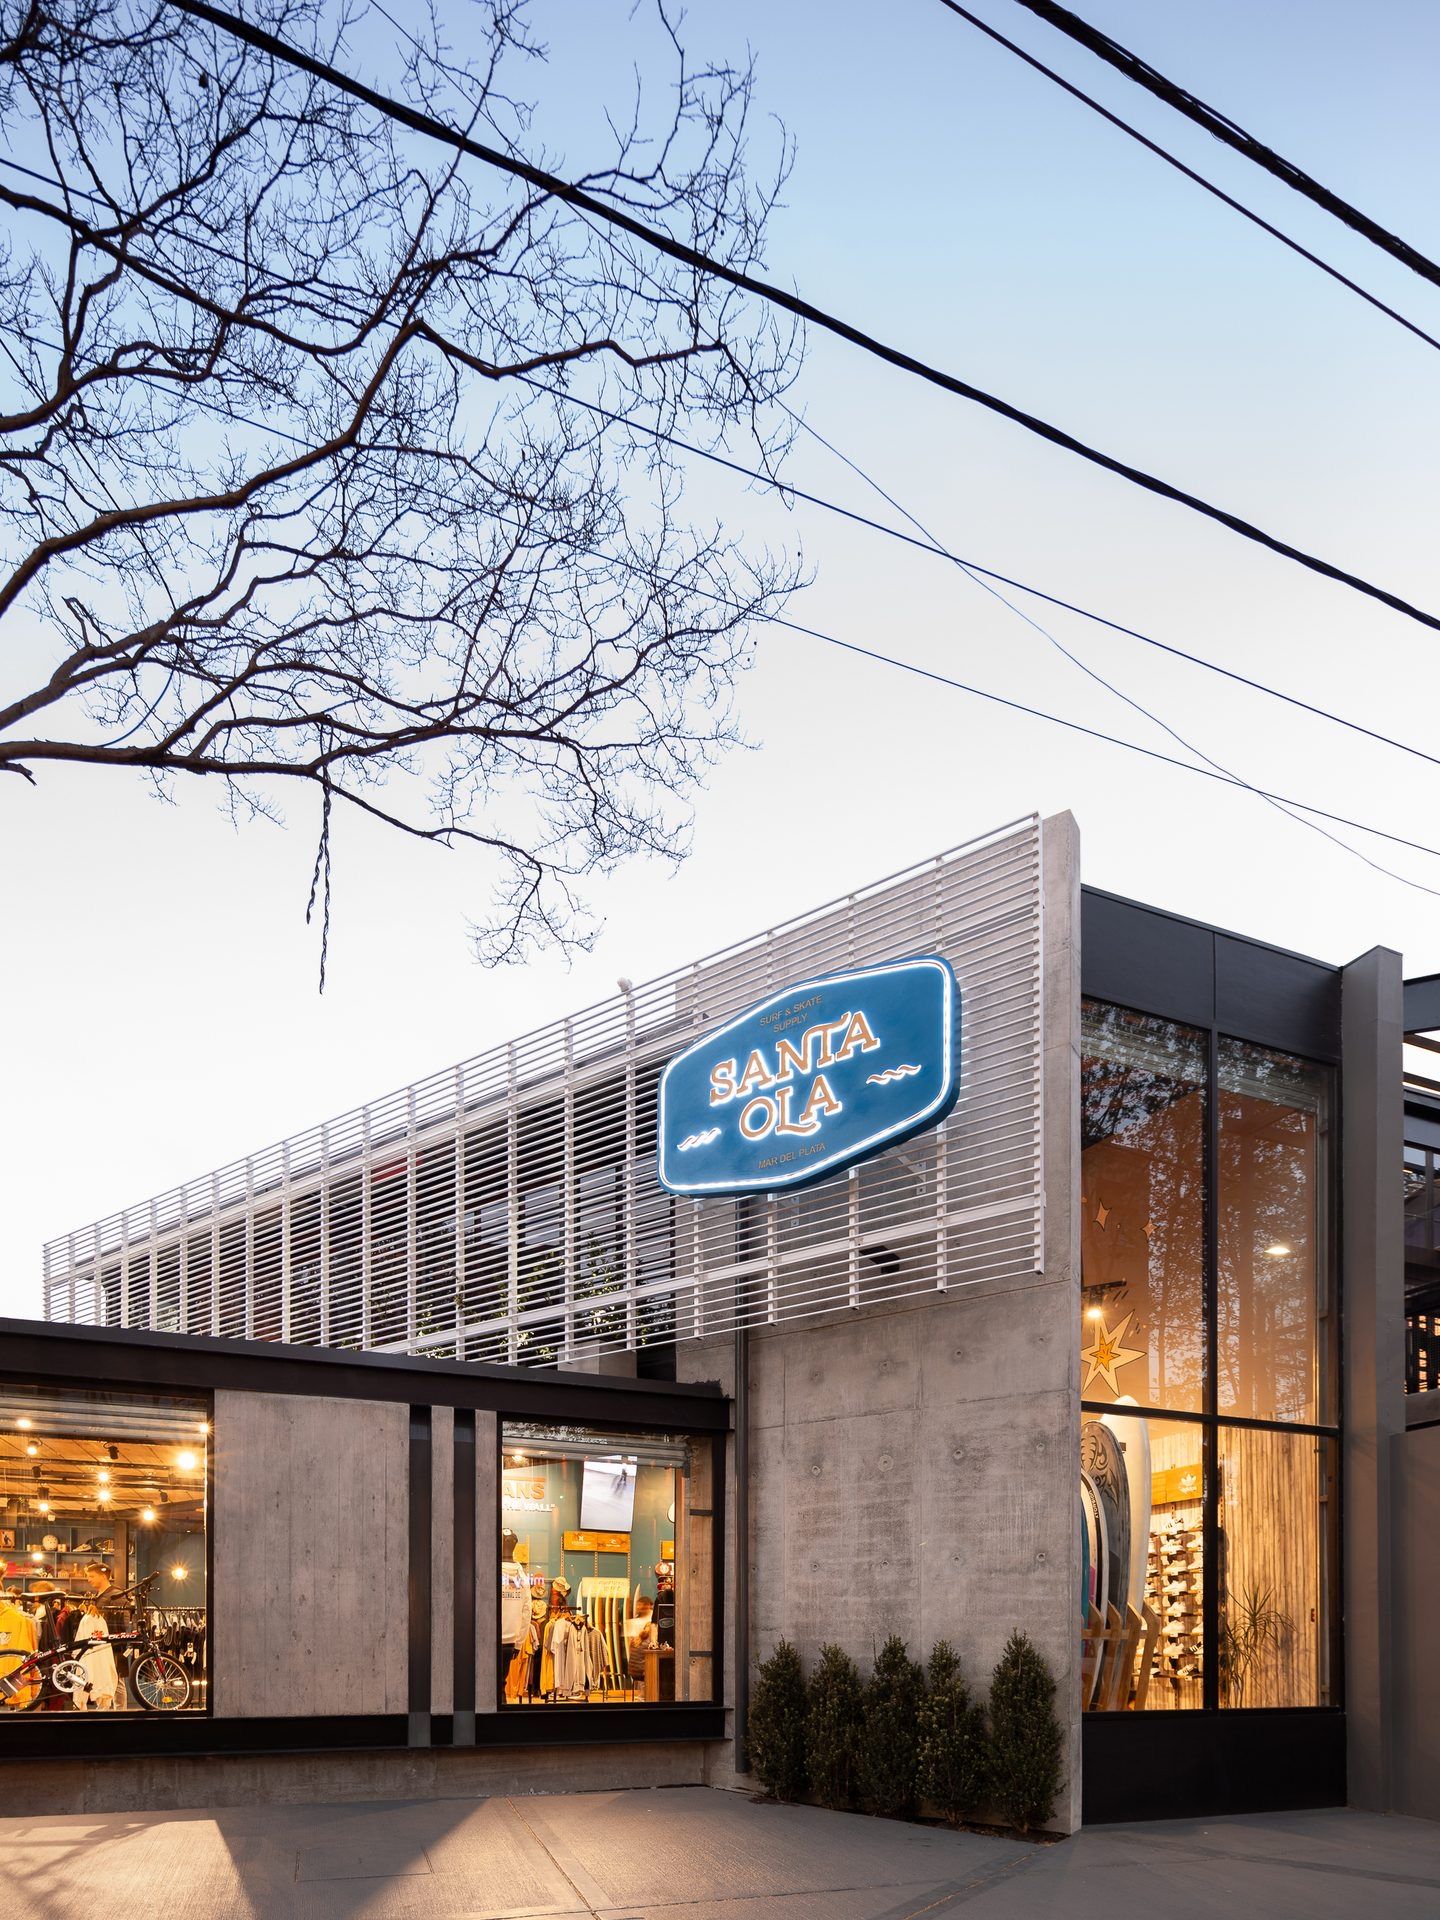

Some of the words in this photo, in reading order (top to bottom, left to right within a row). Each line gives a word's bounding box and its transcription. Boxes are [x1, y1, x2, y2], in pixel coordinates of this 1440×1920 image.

[760, 1010, 783, 1026] SURF
[785, 1008, 792, 1016] &
[793, 994, 823, 1013] SKATE
[773, 1012, 808, 1033] SUPPLY
[709, 1010, 881, 1107] SANTA
[738, 1074, 843, 1140] OLA
[758, 1156, 778, 1169] MAR
[780, 1151, 797, 1163] DEL
[799, 1142, 826, 1157] PLATA
[502, 1483, 545, 1500] ANS
